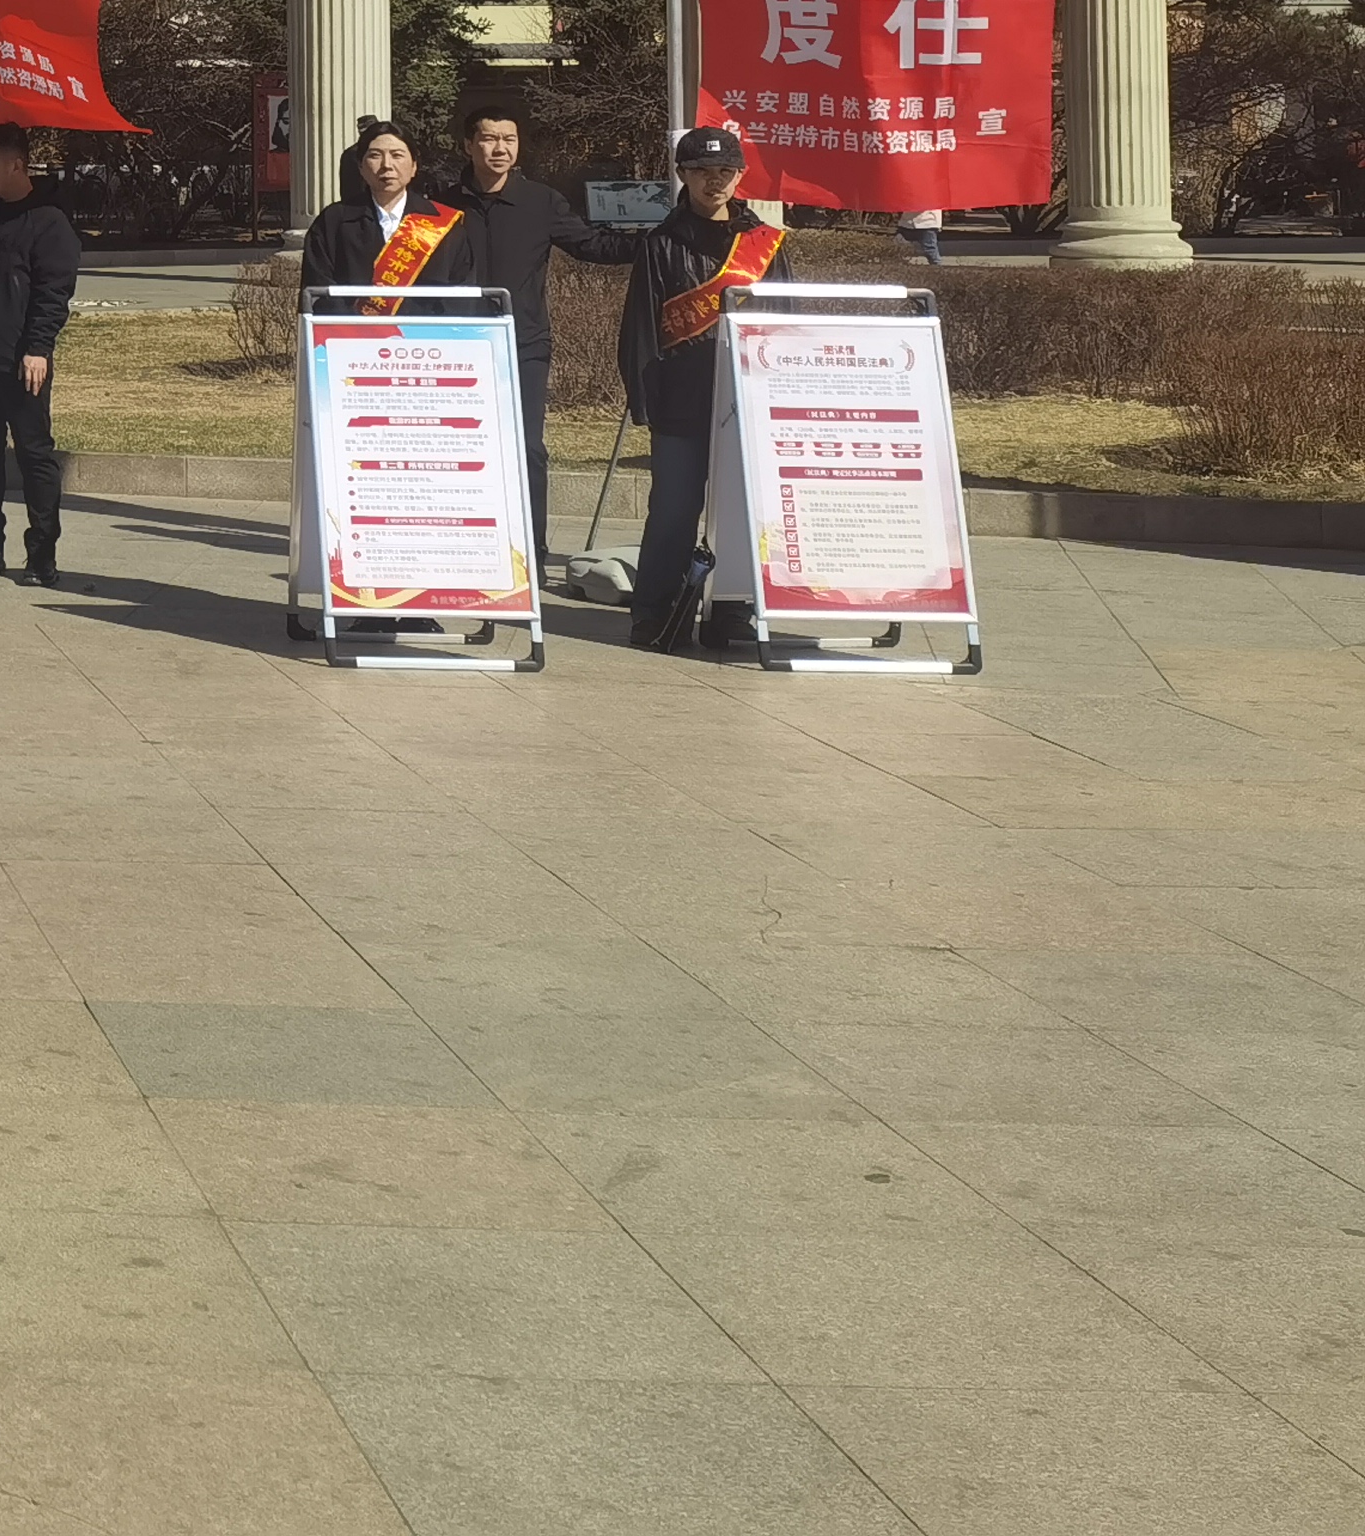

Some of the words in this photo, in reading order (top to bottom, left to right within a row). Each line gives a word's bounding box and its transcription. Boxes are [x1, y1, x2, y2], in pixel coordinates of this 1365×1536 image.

[722, 90, 957, 121] 兴安盟自然资源局
[975, 107, 1008, 136] 宣
[812, 345, 856, 356] 一图读懂
[348, 362, 475, 372] 中华人民共和国土地管理法
[776, 355, 895, 368] 《中华人民共和国民法典》
